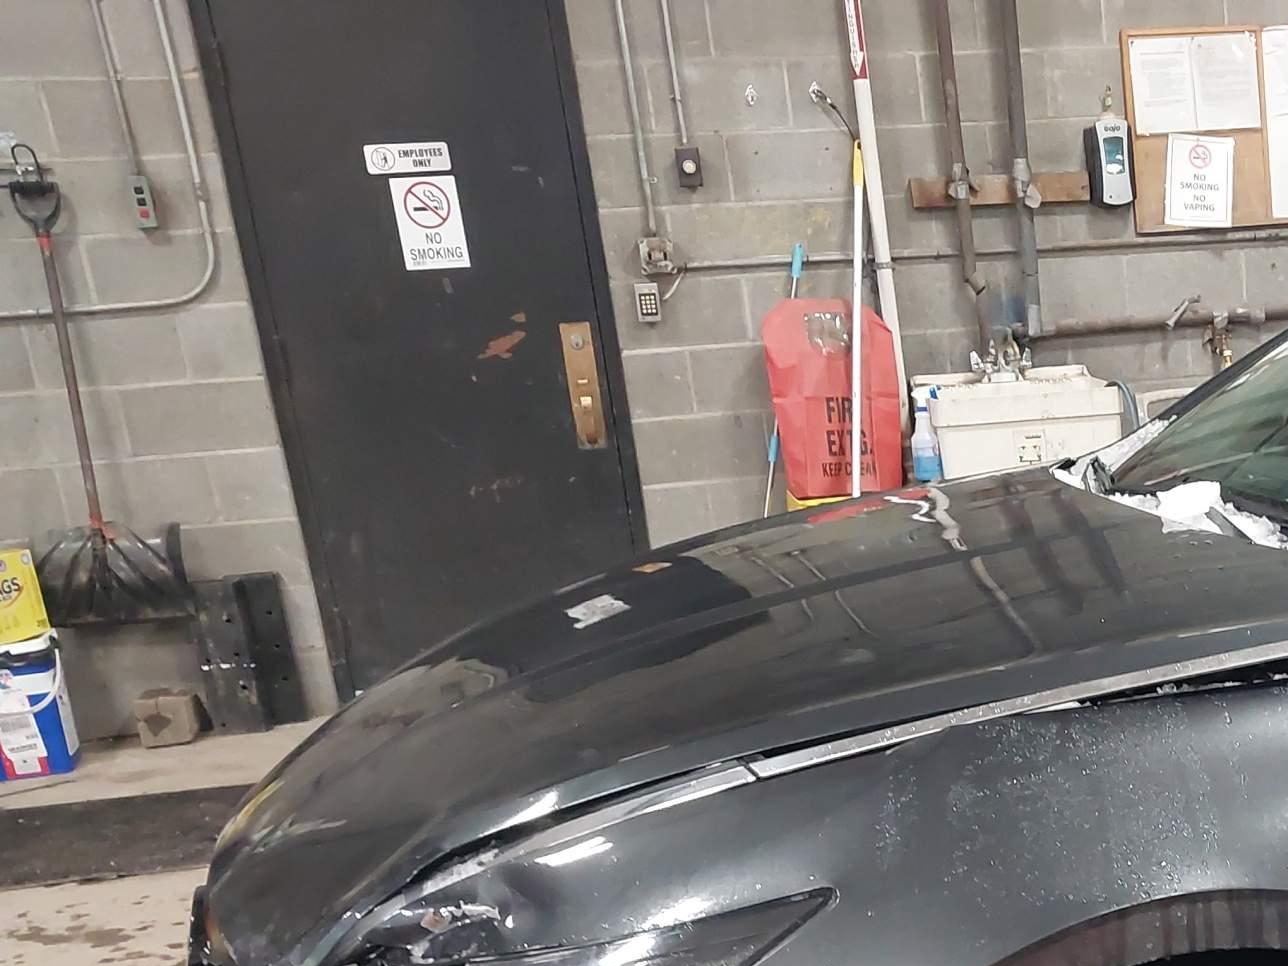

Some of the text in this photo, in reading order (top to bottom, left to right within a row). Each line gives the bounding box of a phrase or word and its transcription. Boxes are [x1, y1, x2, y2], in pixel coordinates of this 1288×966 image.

[398, 147, 443, 158] EMPLOYEES
[412, 158, 432, 168] ONLY
[1193, 173, 1206, 181] NO
[1180, 181, 1219, 191] SMOKING
[1193, 194, 1205, 202] NO
[1184, 202, 1215, 212] VAPING
[425, 232, 442, 244] NO
[410, 246, 463, 261] SMOKING
[825, 397, 854, 424] FIR
[822, 462, 842, 477] KEEP
[0, 577, 21, 595] GS
